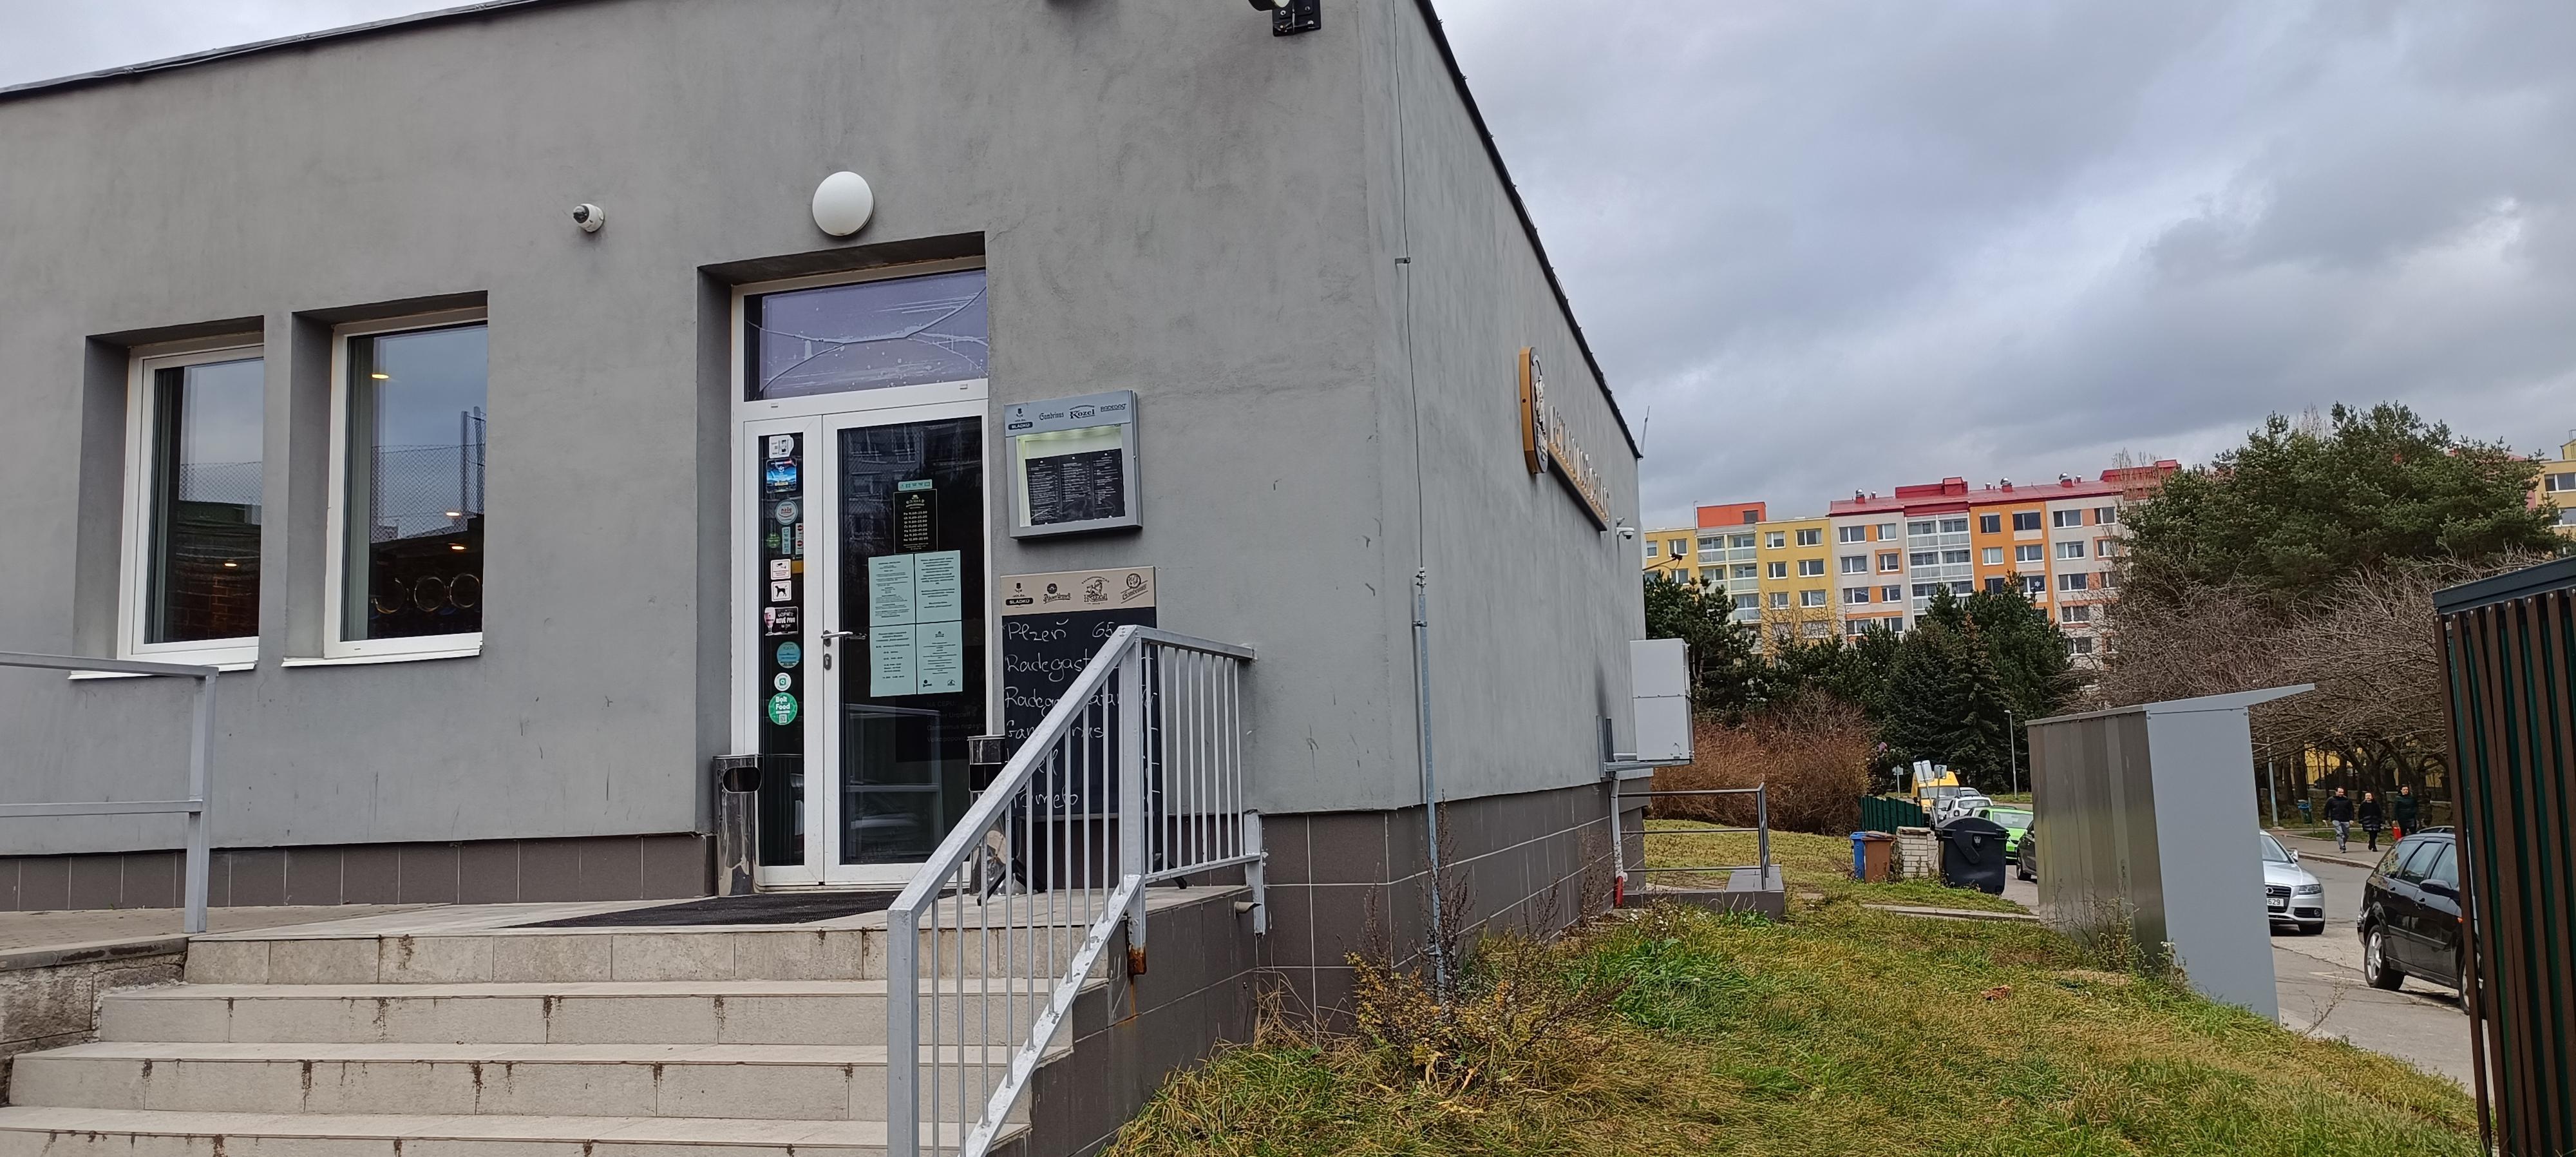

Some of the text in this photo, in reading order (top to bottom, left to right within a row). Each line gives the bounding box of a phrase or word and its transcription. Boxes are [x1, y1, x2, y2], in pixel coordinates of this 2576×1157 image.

[1070, 408, 1095, 419] Kozel
[1084, 593, 1108, 602] Kozel
[1005, 618, 1069, 642] Plzeň
